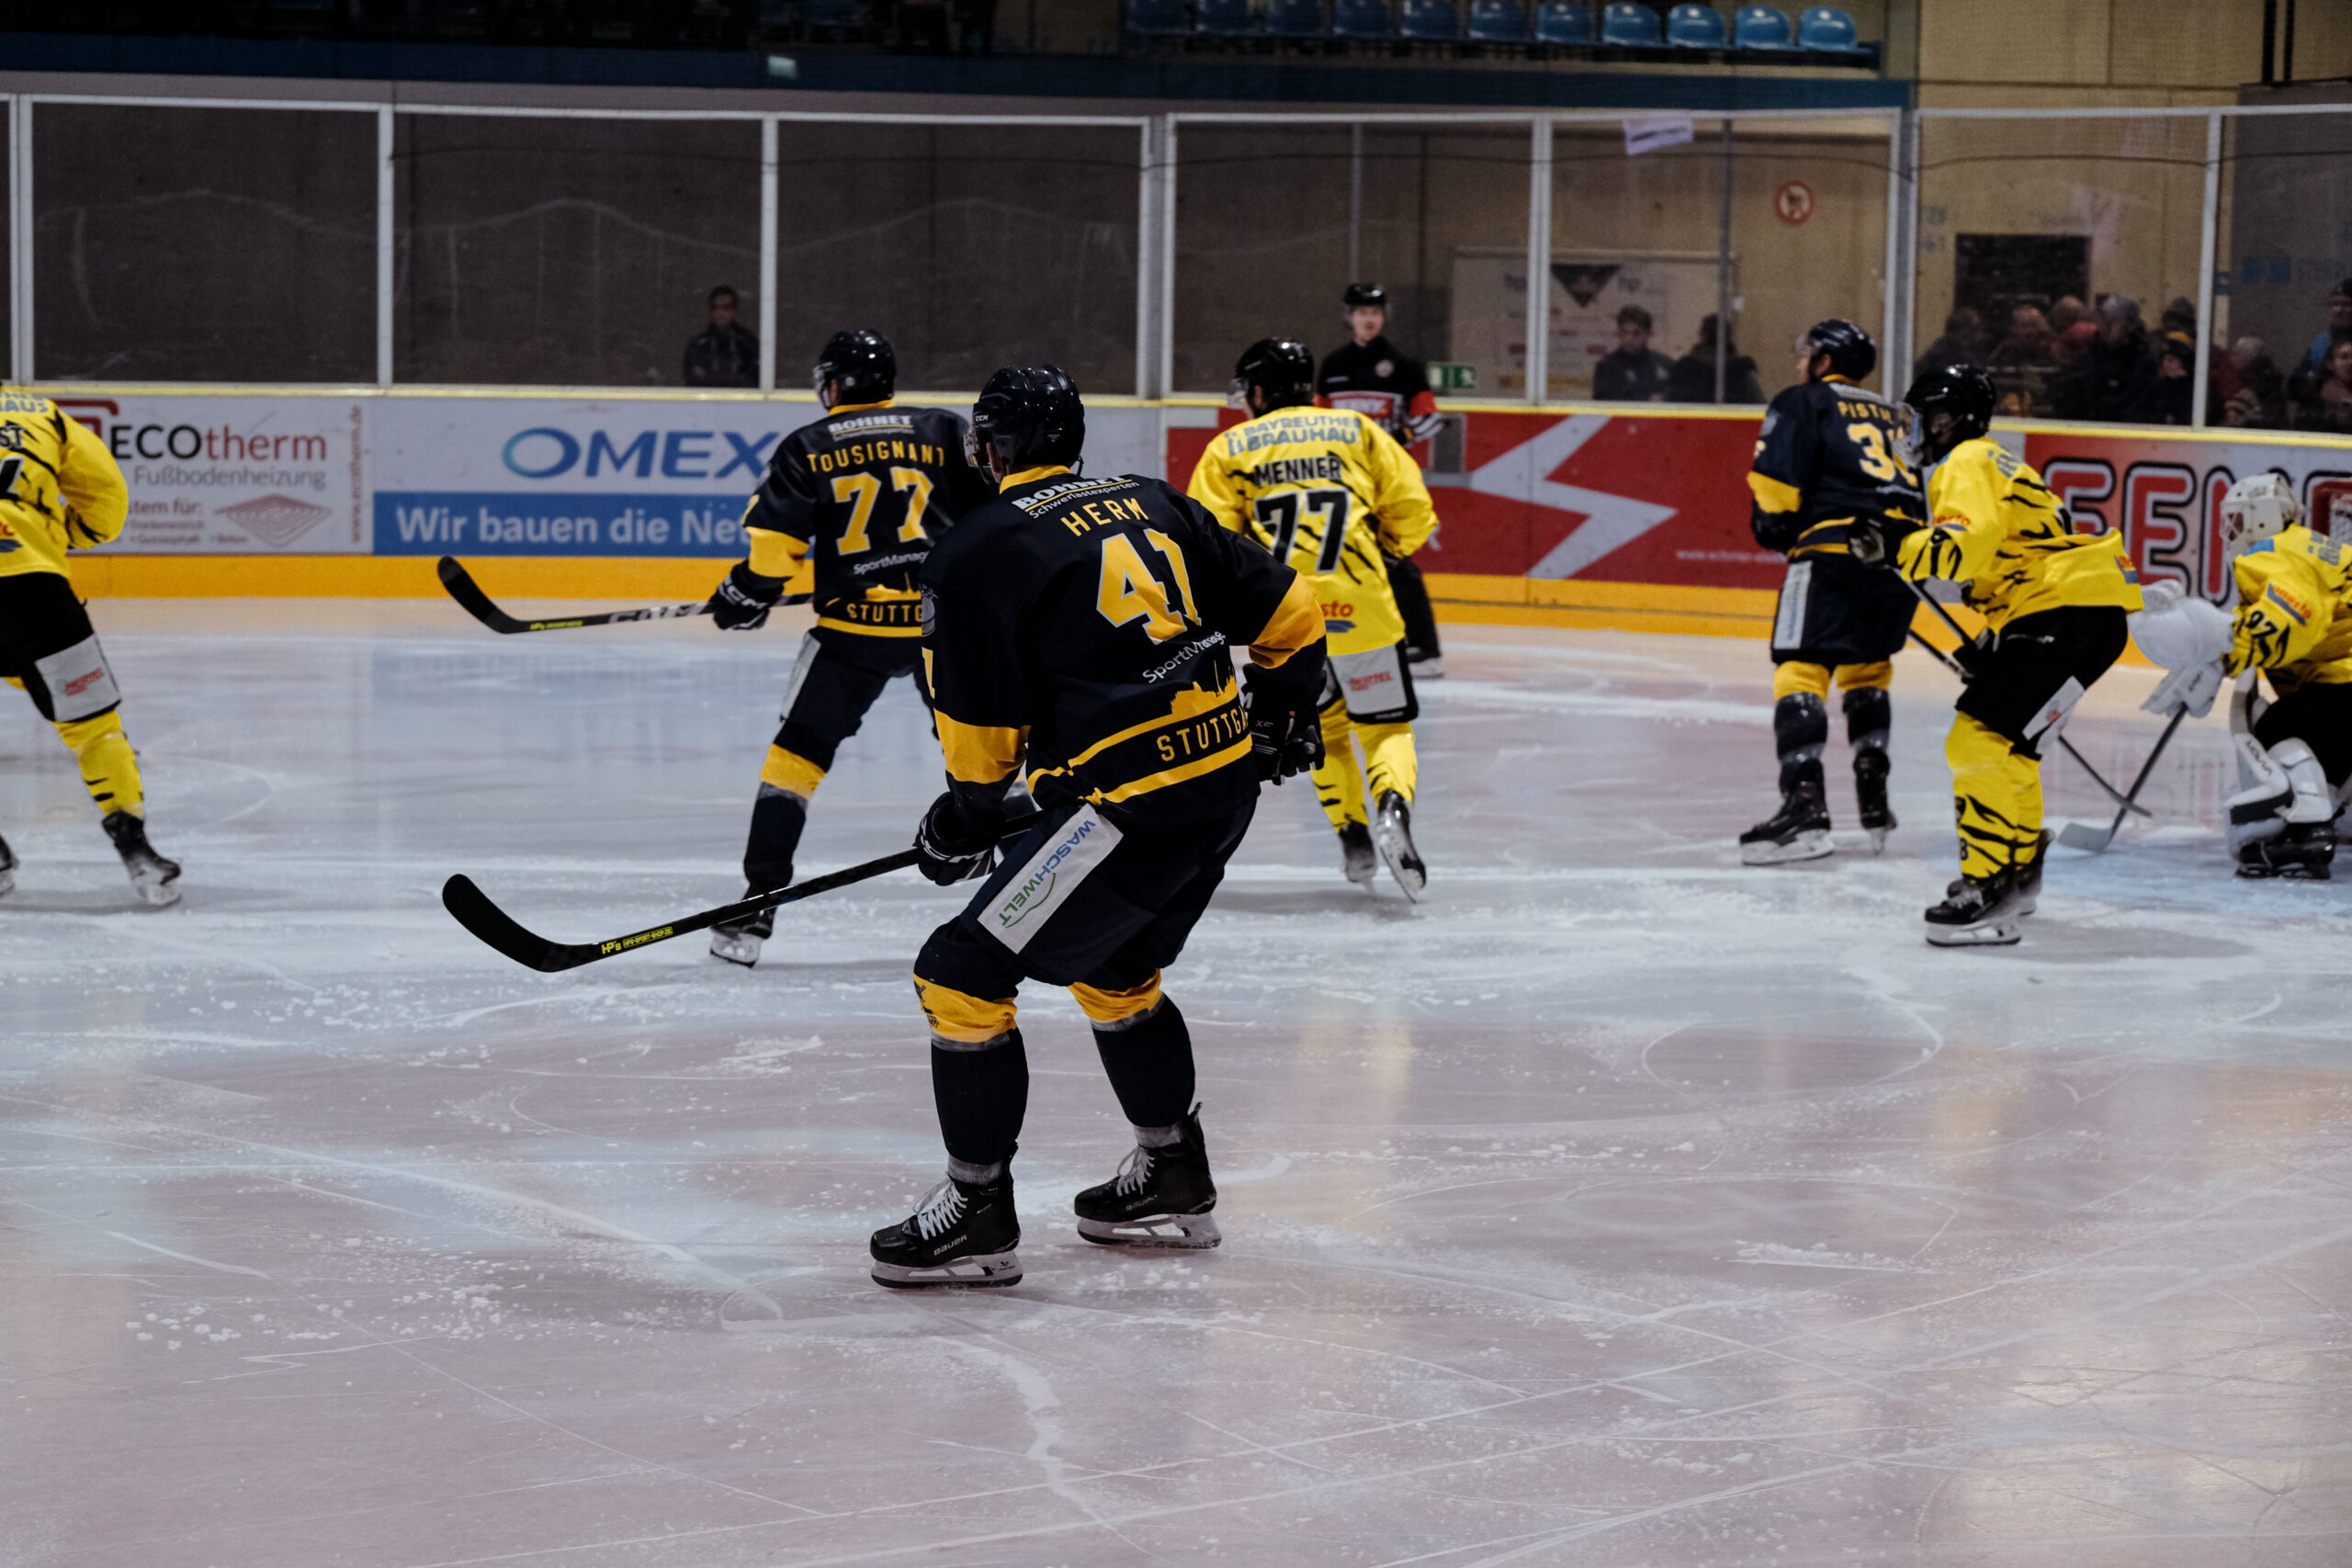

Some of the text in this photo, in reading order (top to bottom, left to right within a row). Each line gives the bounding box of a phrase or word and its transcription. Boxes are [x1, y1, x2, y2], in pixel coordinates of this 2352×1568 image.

[110, 423, 327, 460] ECOtherm
[828, 415, 912, 433] BOHNET
[502, 427, 779, 479] OMEX
[133, 465, 326, 490] Fußbodenheizung
[1254, 457, 1343, 488] MENNER
[831, 466, 934, 556] 77
[1029, 482, 1140, 519] Schwerlastexperten
[1060, 498, 1149, 537] HERM
[397, 506, 469, 543] Wir
[479, 507, 598, 544] bauen
[609, 508, 670, 544] die
[1254, 487, 1349, 574] 77
[1096, 528, 1203, 645] 41
[998, 819, 1096, 927] WASCHWELT
[933, 1235, 967, 1257] BAUER
